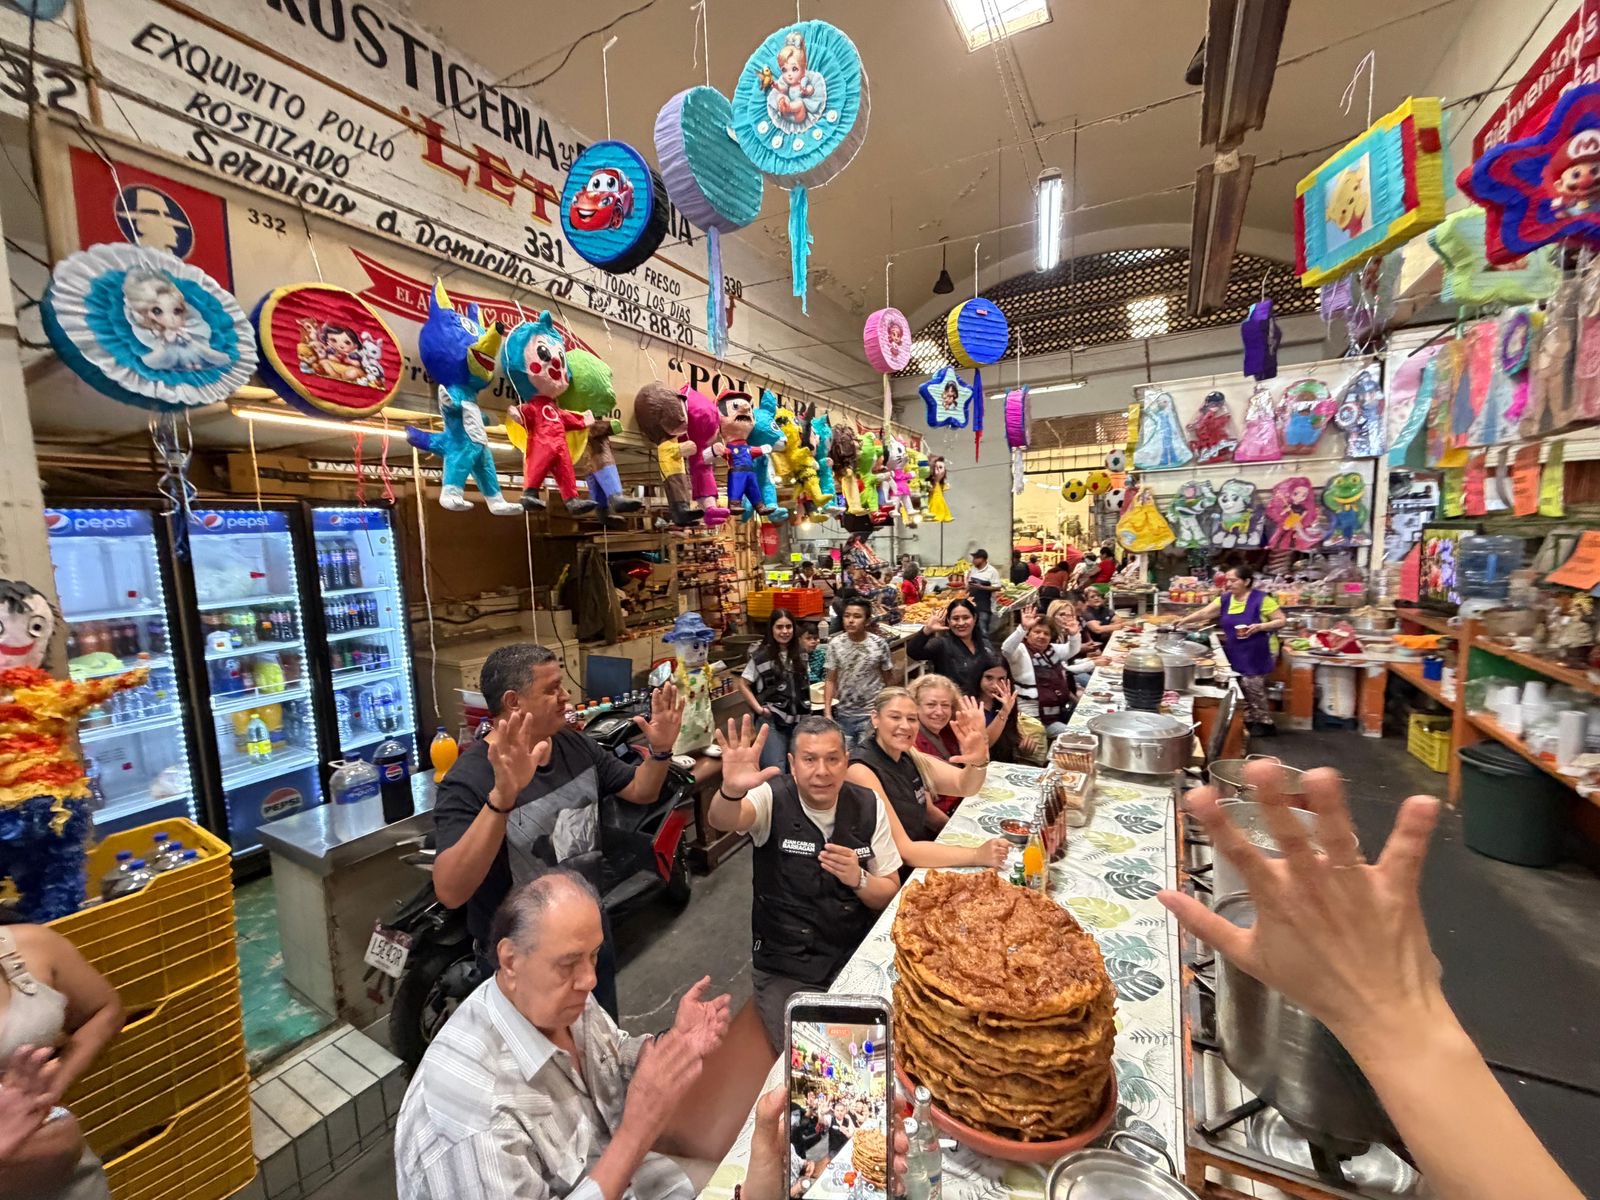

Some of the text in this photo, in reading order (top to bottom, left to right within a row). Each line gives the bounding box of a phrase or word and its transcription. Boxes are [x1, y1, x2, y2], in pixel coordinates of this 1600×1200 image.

[131, 23, 395, 162] EXQUISITO POLLO
[184, 91, 350, 179] ROSTIZADO
[187, 130, 357, 216] Servicio
[415, 219, 537, 286] Domicilio
[247, 207, 287, 234] 332
[524, 226, 566, 268] 331
[395, 286, 414, 305] EL
[645, 266, 681, 297] FRESCO
[724, 275, 743, 299] 330
[604, 271, 640, 303] TODOS
[646, 290, 666, 314] LOS
[670, 301, 692, 324] DIAS
[74, 515, 134, 532] pepsi
[227, 515, 270, 530] pepsi
